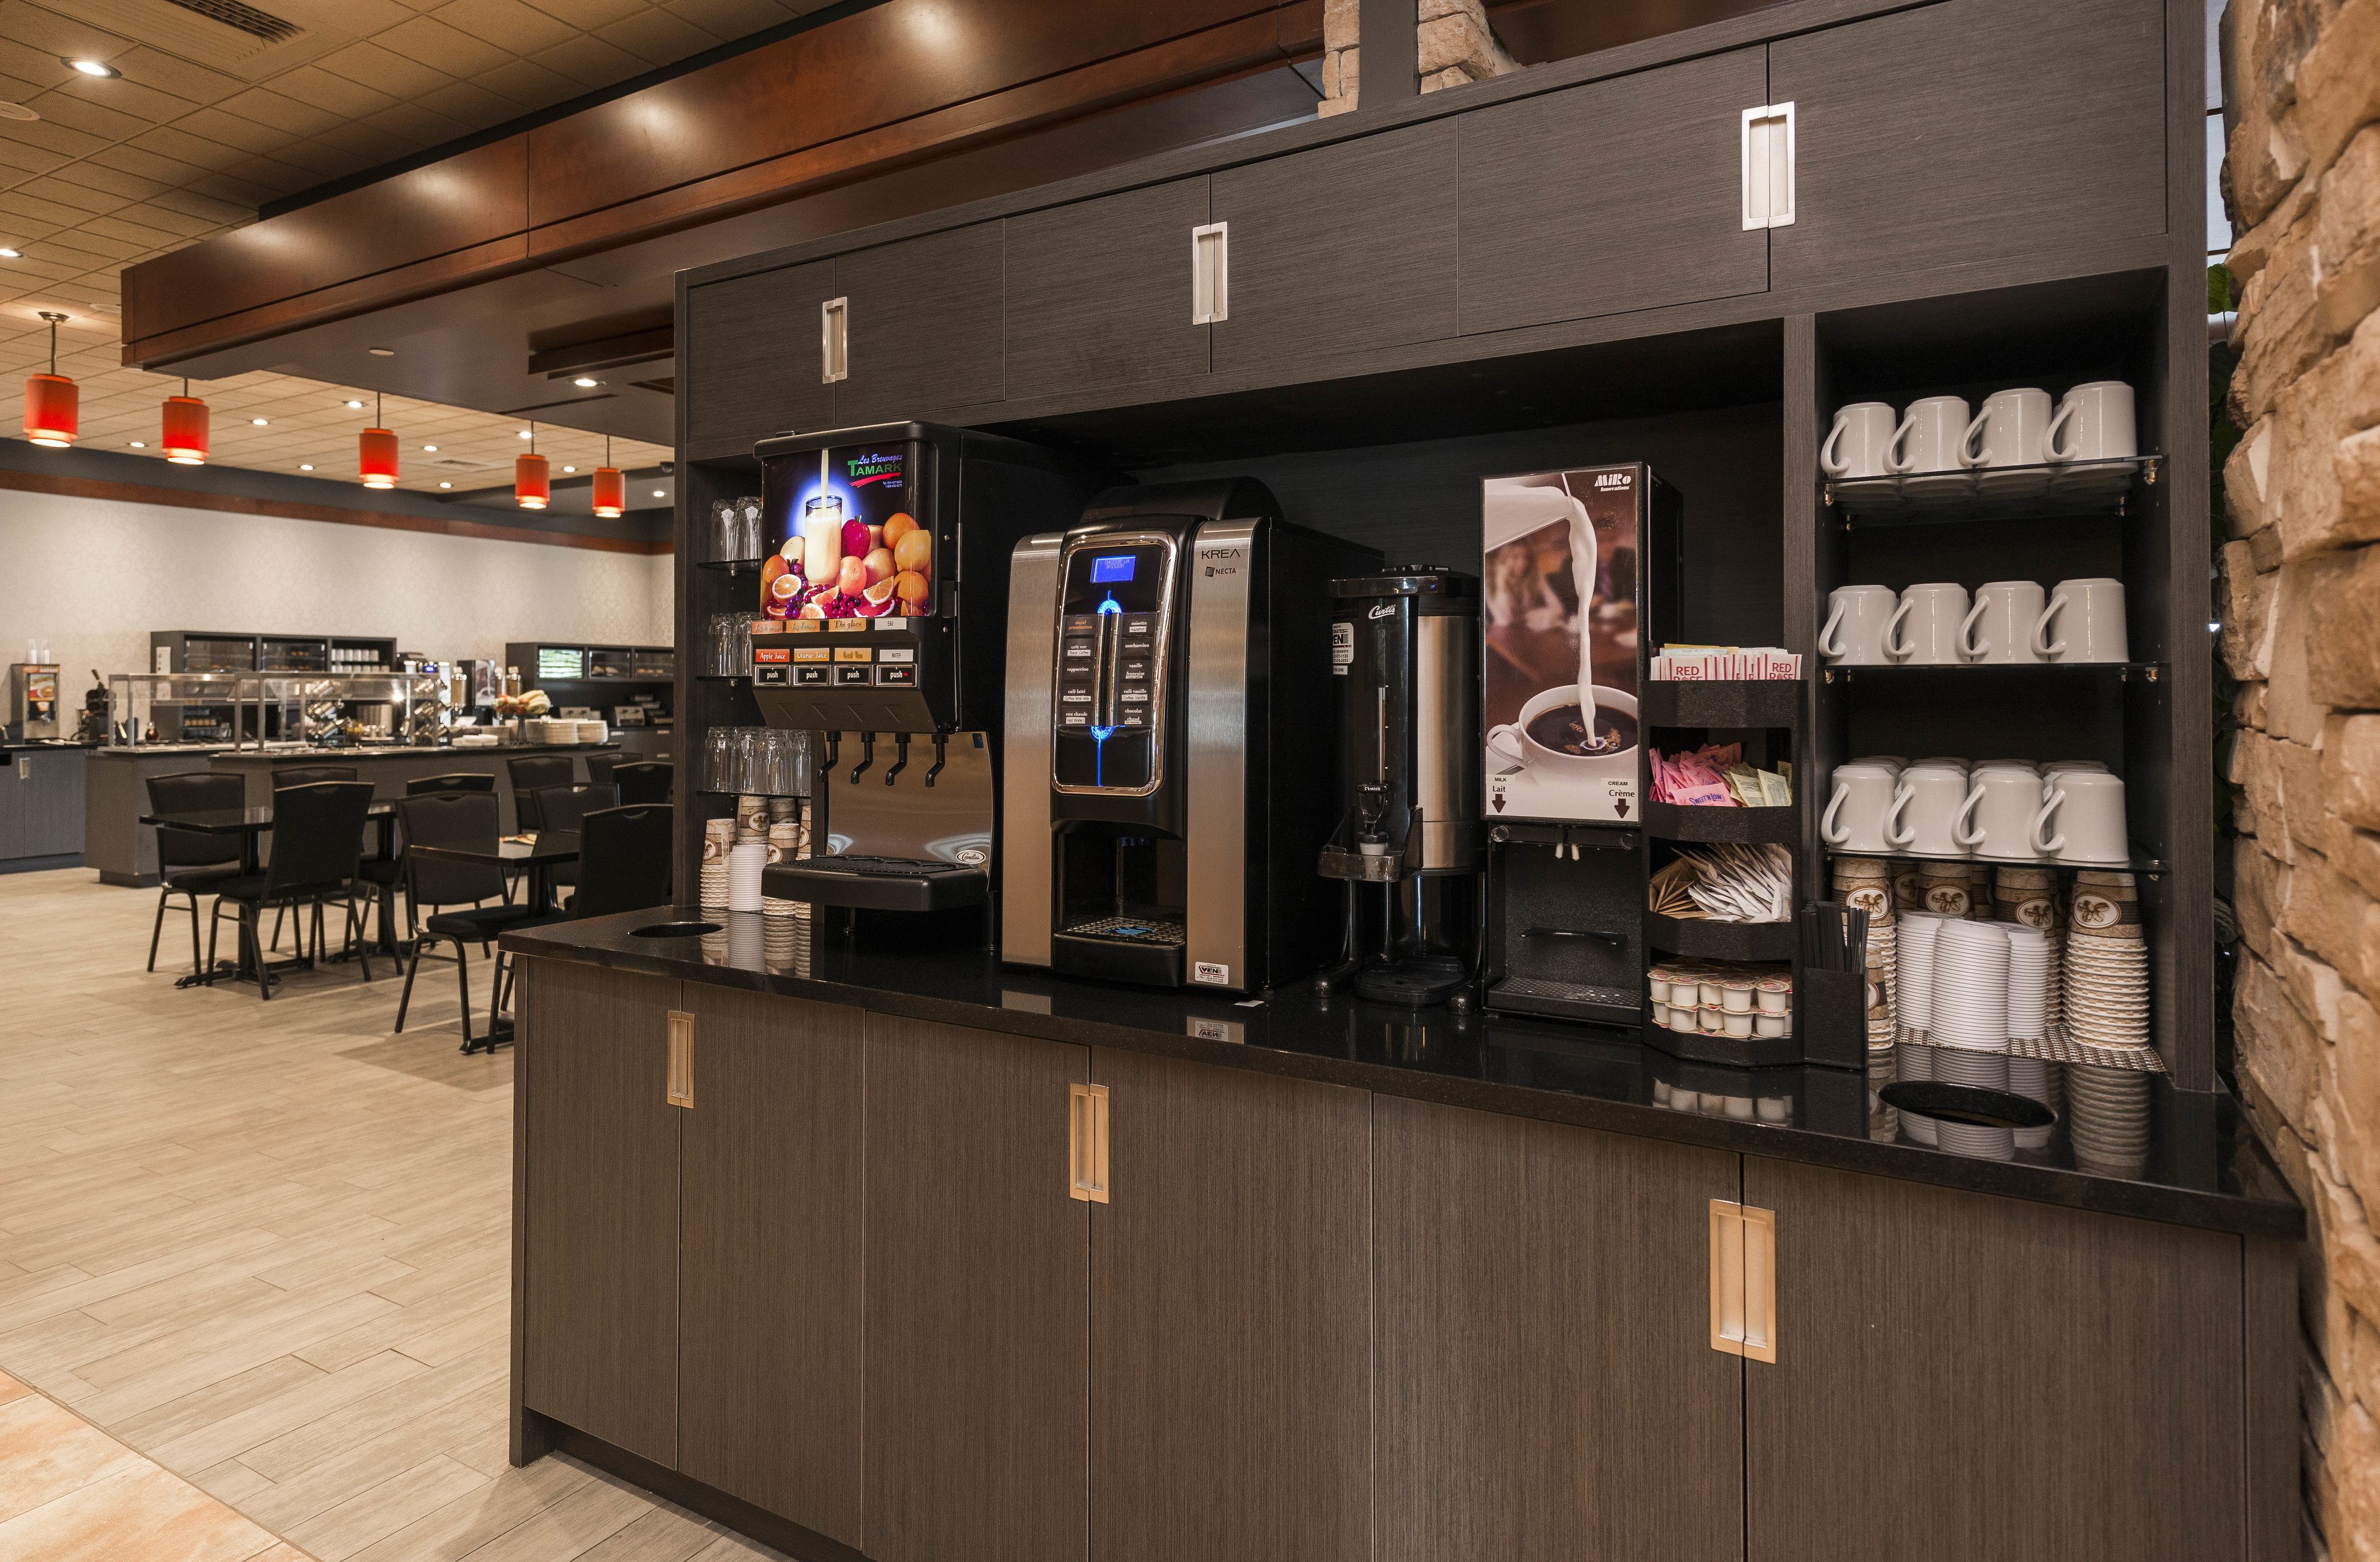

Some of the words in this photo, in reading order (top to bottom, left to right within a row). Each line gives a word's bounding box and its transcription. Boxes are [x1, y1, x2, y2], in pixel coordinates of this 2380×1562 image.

[858, 455, 870, 465] Les
[871, 454, 902, 463] Breuvages
[847, 460, 902, 476] TAMARK
[1201, 548, 1241, 559] KREA
[1368, 604, 1396, 619] Curtis
[760, 652, 774, 662] Apple
[797, 652, 814, 661] Orange
[1676, 666, 1699, 675] RED
[1772, 662, 1792, 673] RED
[767, 670, 778, 680] push
[806, 670, 818, 680] push
[847, 670, 860, 680] push
[890, 670, 903, 680] push
[1608, 789, 1635, 797] Crème
